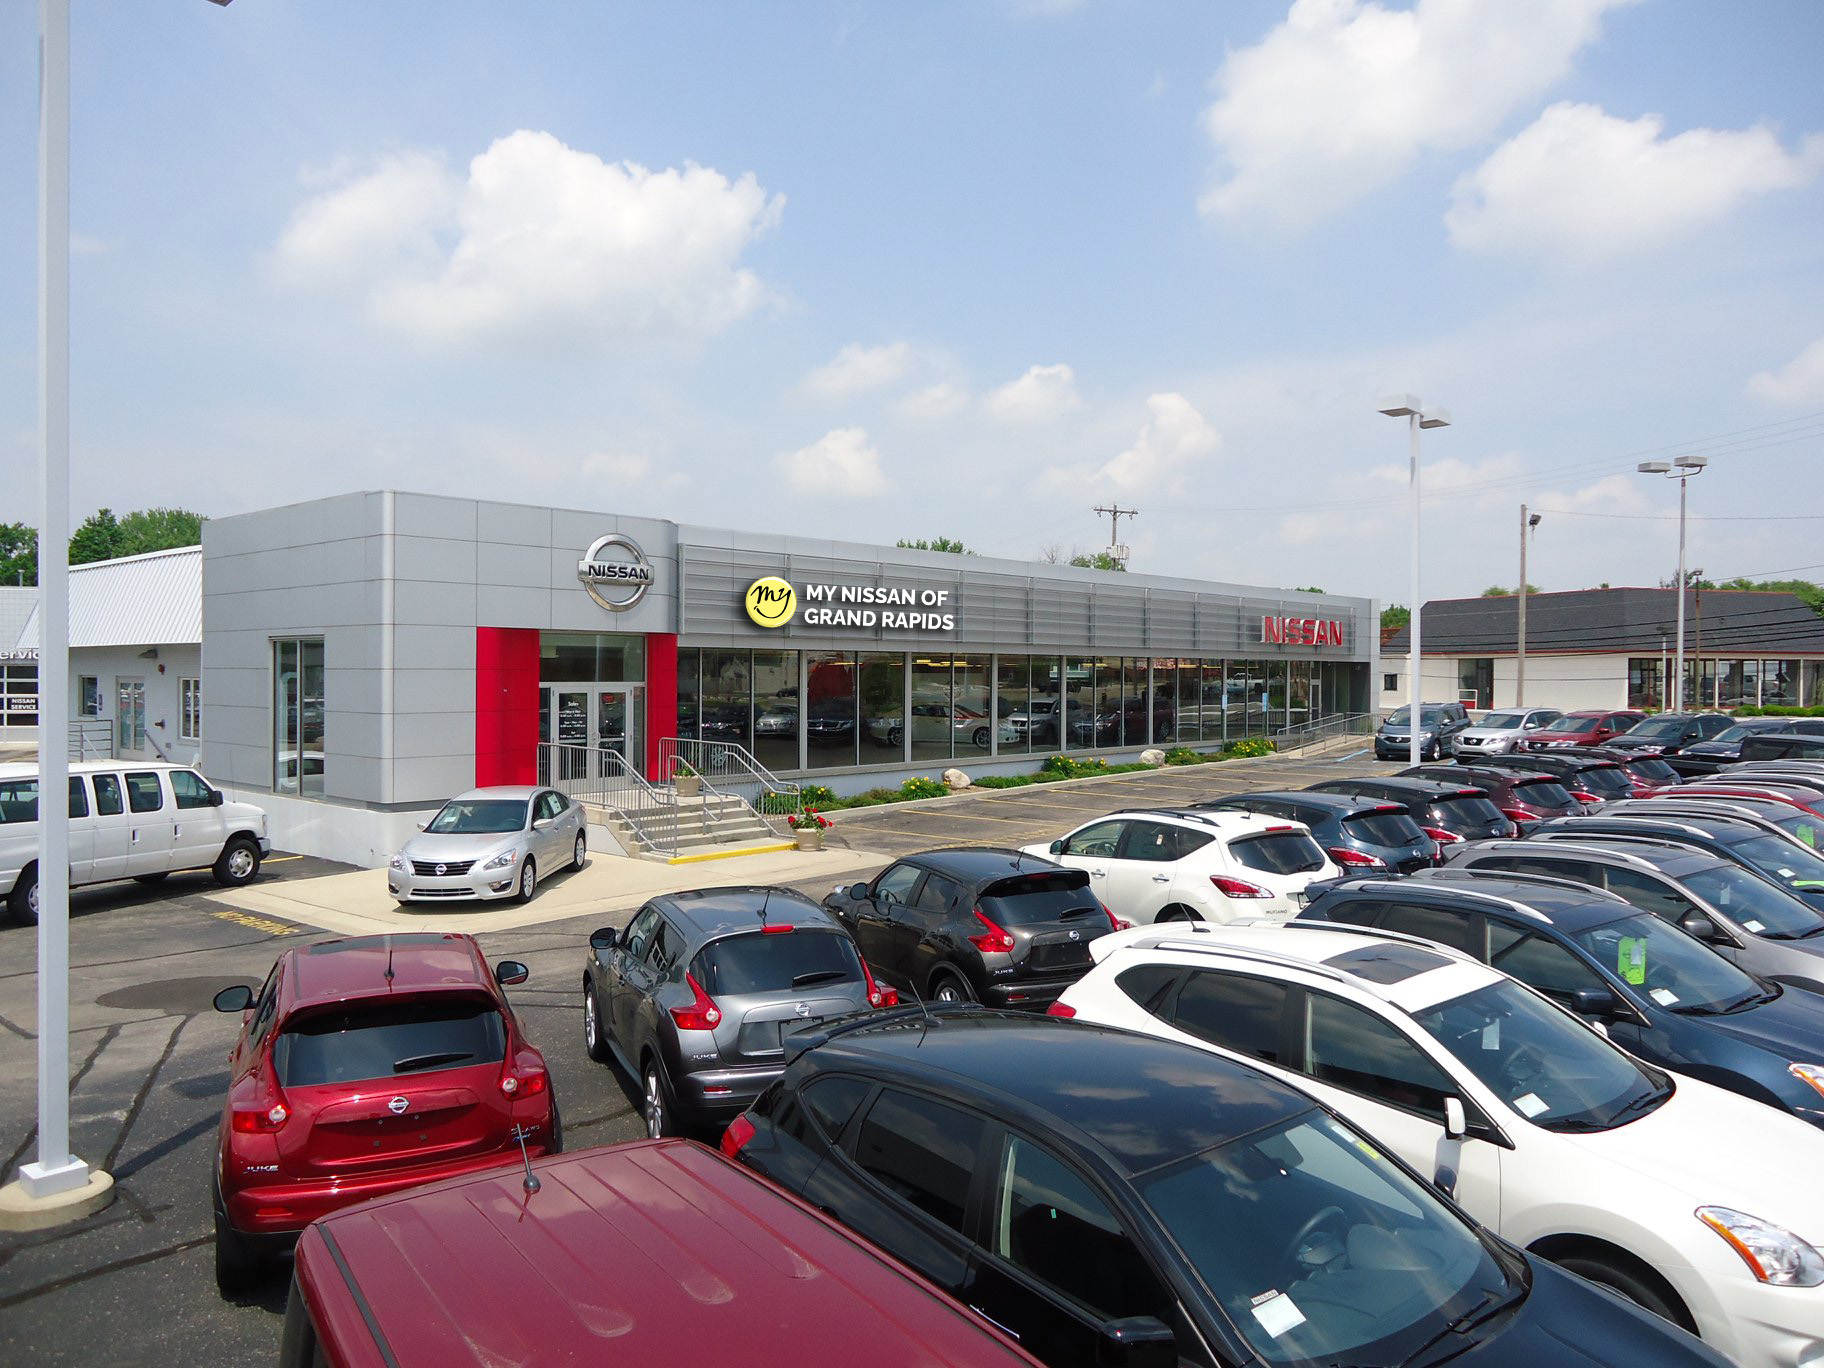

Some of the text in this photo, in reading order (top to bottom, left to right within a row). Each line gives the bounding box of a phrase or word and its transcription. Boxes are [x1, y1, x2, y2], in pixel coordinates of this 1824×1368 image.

[588, 565, 649, 580] NISSAN
[806, 584, 949, 607] MY NISSAN OF
[804, 608, 955, 631] GRAND RAPIDS
[1261, 615, 1343, 646] NISSAN
[243, 1165, 279, 1174] JUKE
